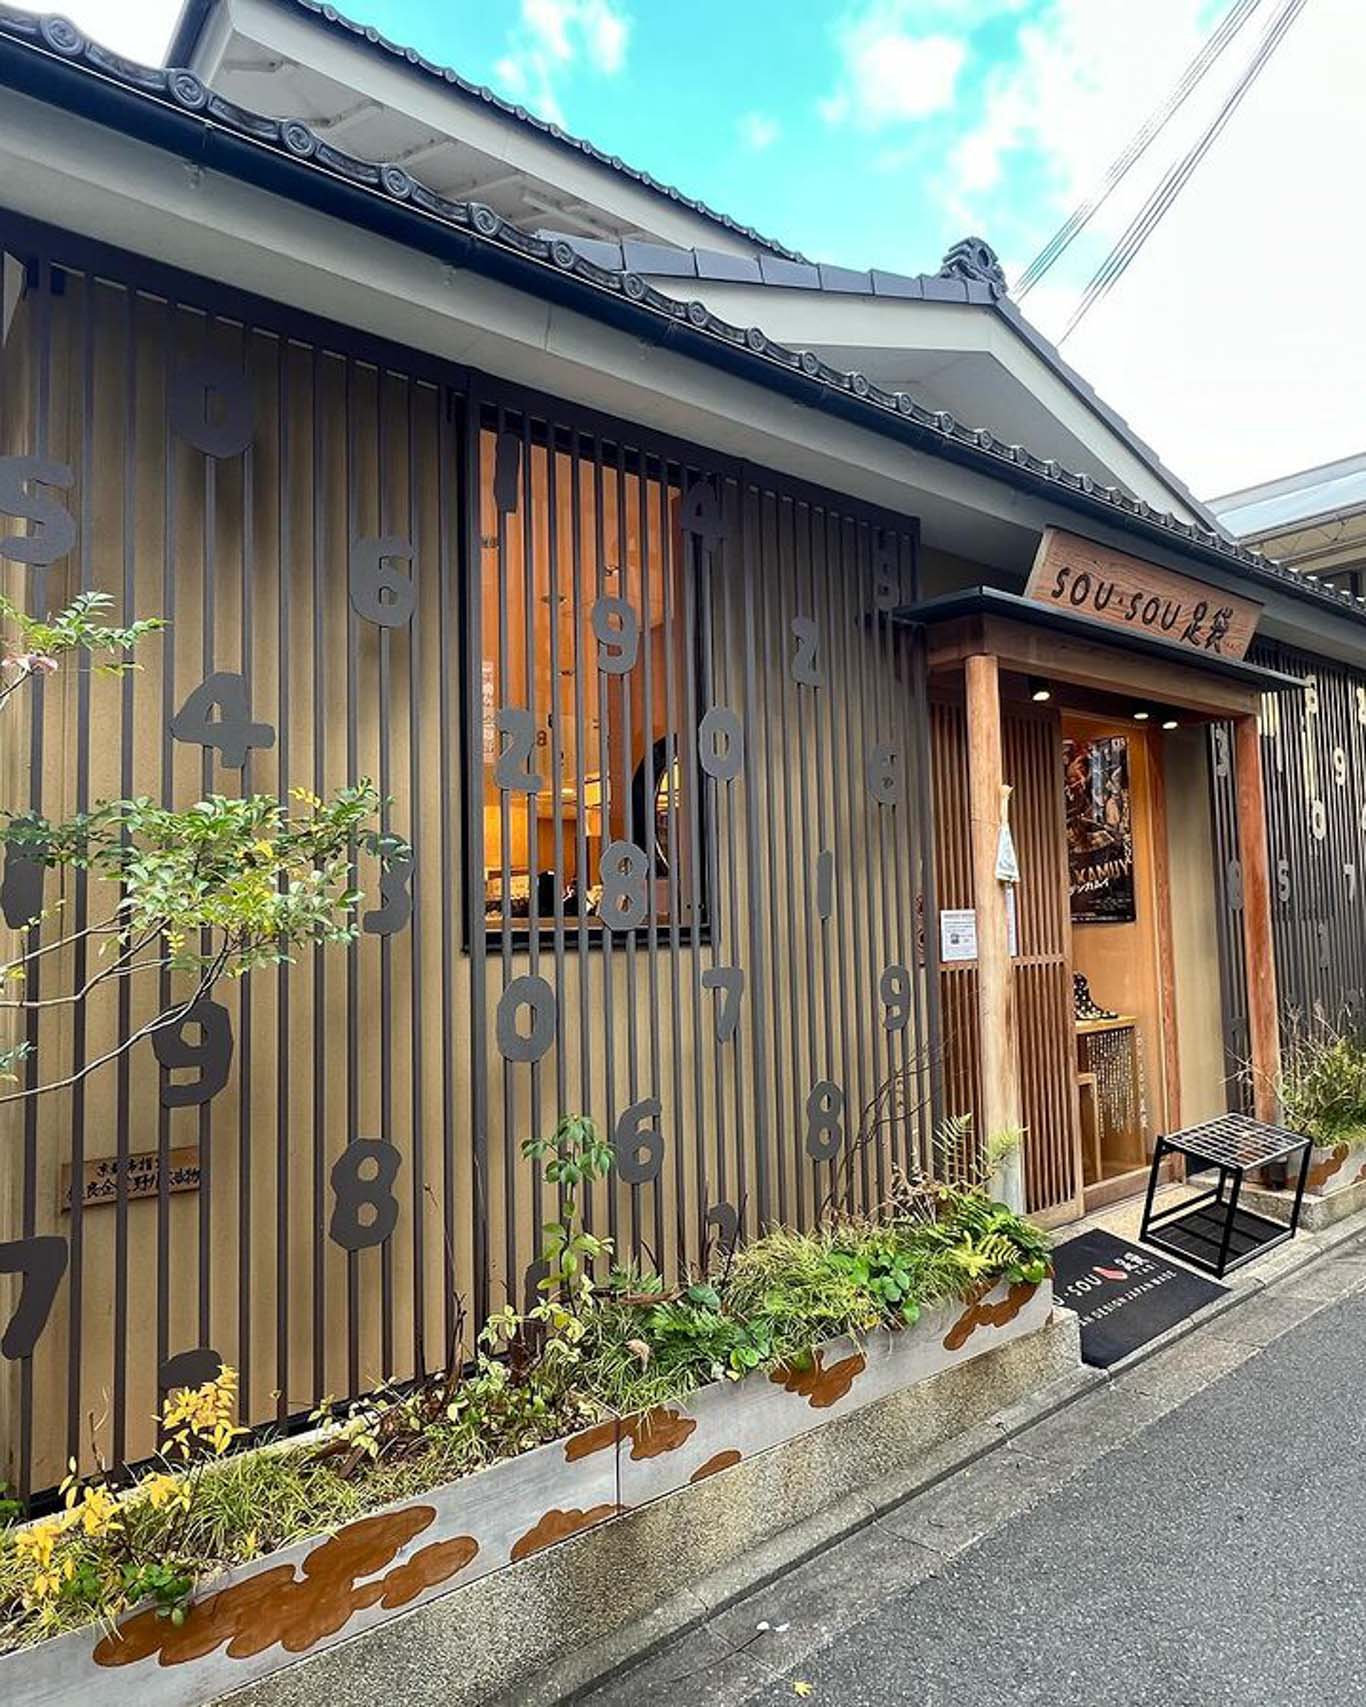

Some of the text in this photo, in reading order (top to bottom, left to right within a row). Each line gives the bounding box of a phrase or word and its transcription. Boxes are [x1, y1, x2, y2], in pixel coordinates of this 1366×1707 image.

[0, 455, 77, 567] 5
[348, 535, 417, 628] 6
[593, 596, 637, 675] 9
[791, 616, 822, 688] 2
[170, 671, 276, 769] 4
[495, 708, 543, 794] 2
[699, 705, 742, 781] 0
[362, 830, 415, 935] 3
[600, 840, 648, 931] 8
[497, 975, 555, 1063] 0
[701, 966, 744, 1044] 7
[880, 964, 910, 1031] 9
[152, 999, 234, 1108] 9
[617, 1097, 664, 1185] 6
[806, 1080, 843, 1161] 8
[329, 1138, 402, 1251] 8
[0, 1236, 68, 1361] 7
